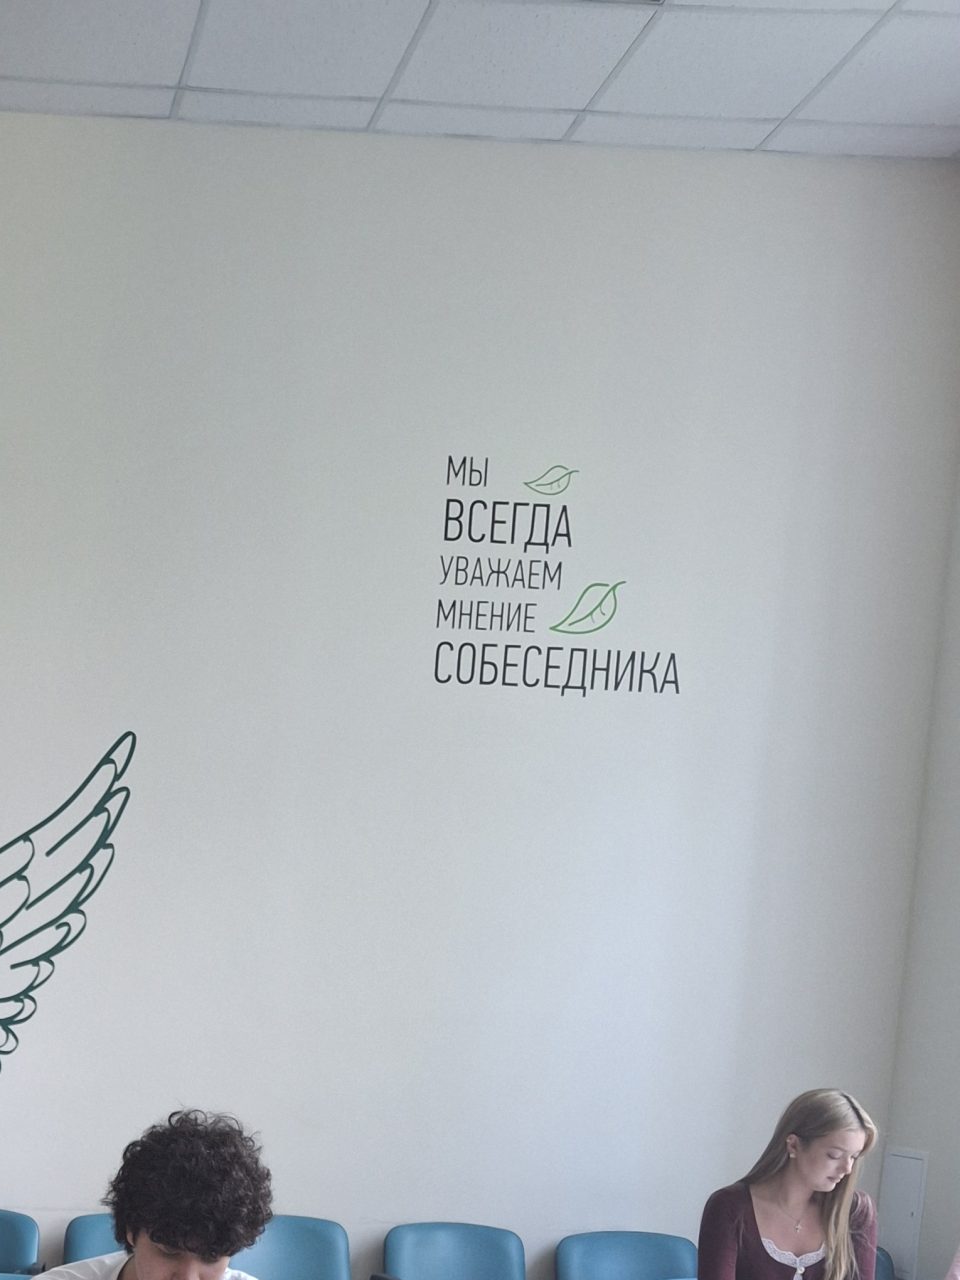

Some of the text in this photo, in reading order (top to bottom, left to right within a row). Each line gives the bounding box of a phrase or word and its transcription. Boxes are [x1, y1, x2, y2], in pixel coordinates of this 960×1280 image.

[446, 455, 489, 487] МЫ
[443, 498, 572, 555] ВСЕГДА
[439, 555, 563, 591] УВАЖАЕМ
[436, 598, 538, 633] МНЕНИЕ
[434, 641, 680, 698] СОБЕСЕДНИКА
